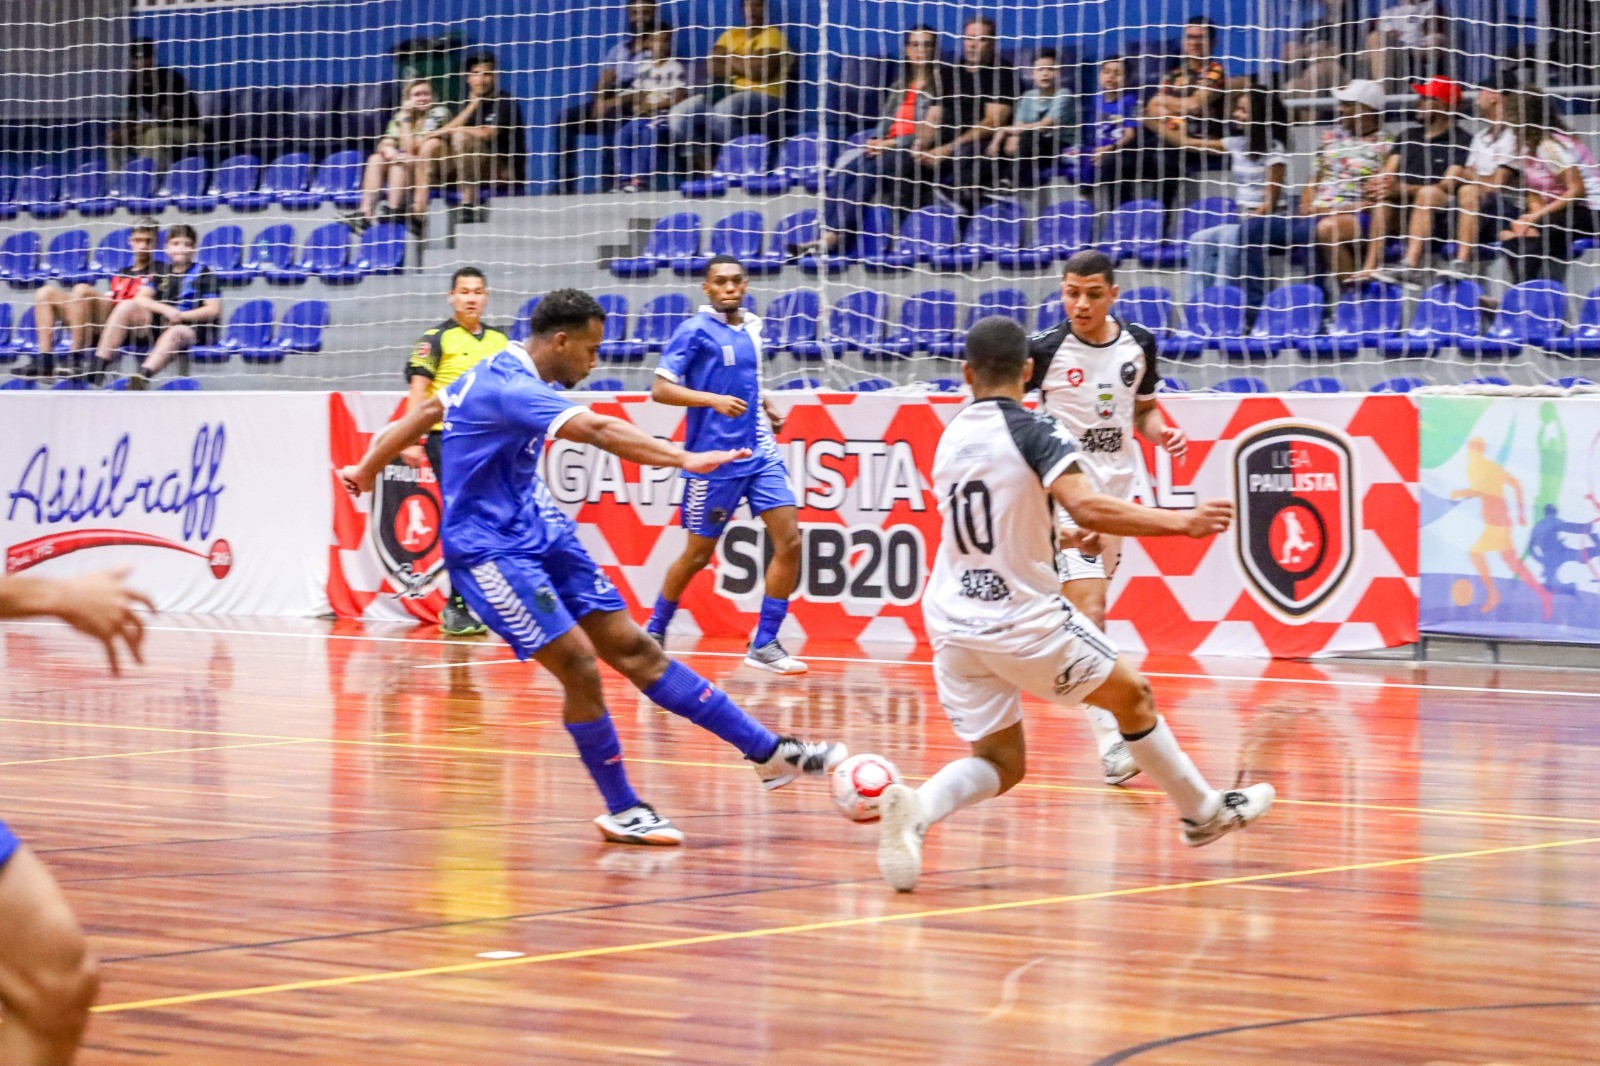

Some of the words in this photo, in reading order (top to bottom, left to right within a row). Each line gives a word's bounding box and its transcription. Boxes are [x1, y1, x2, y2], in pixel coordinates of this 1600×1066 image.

[8, 421, 226, 541] Assibraff
[384, 464, 438, 484] PAULIS
[544, 438, 631, 505] GA
[640, 436, 926, 512] PISTA
[1248, 472, 1339, 493] PAULISTA
[1271, 449, 1313, 469] LIGA
[948, 479, 995, 556] 10
